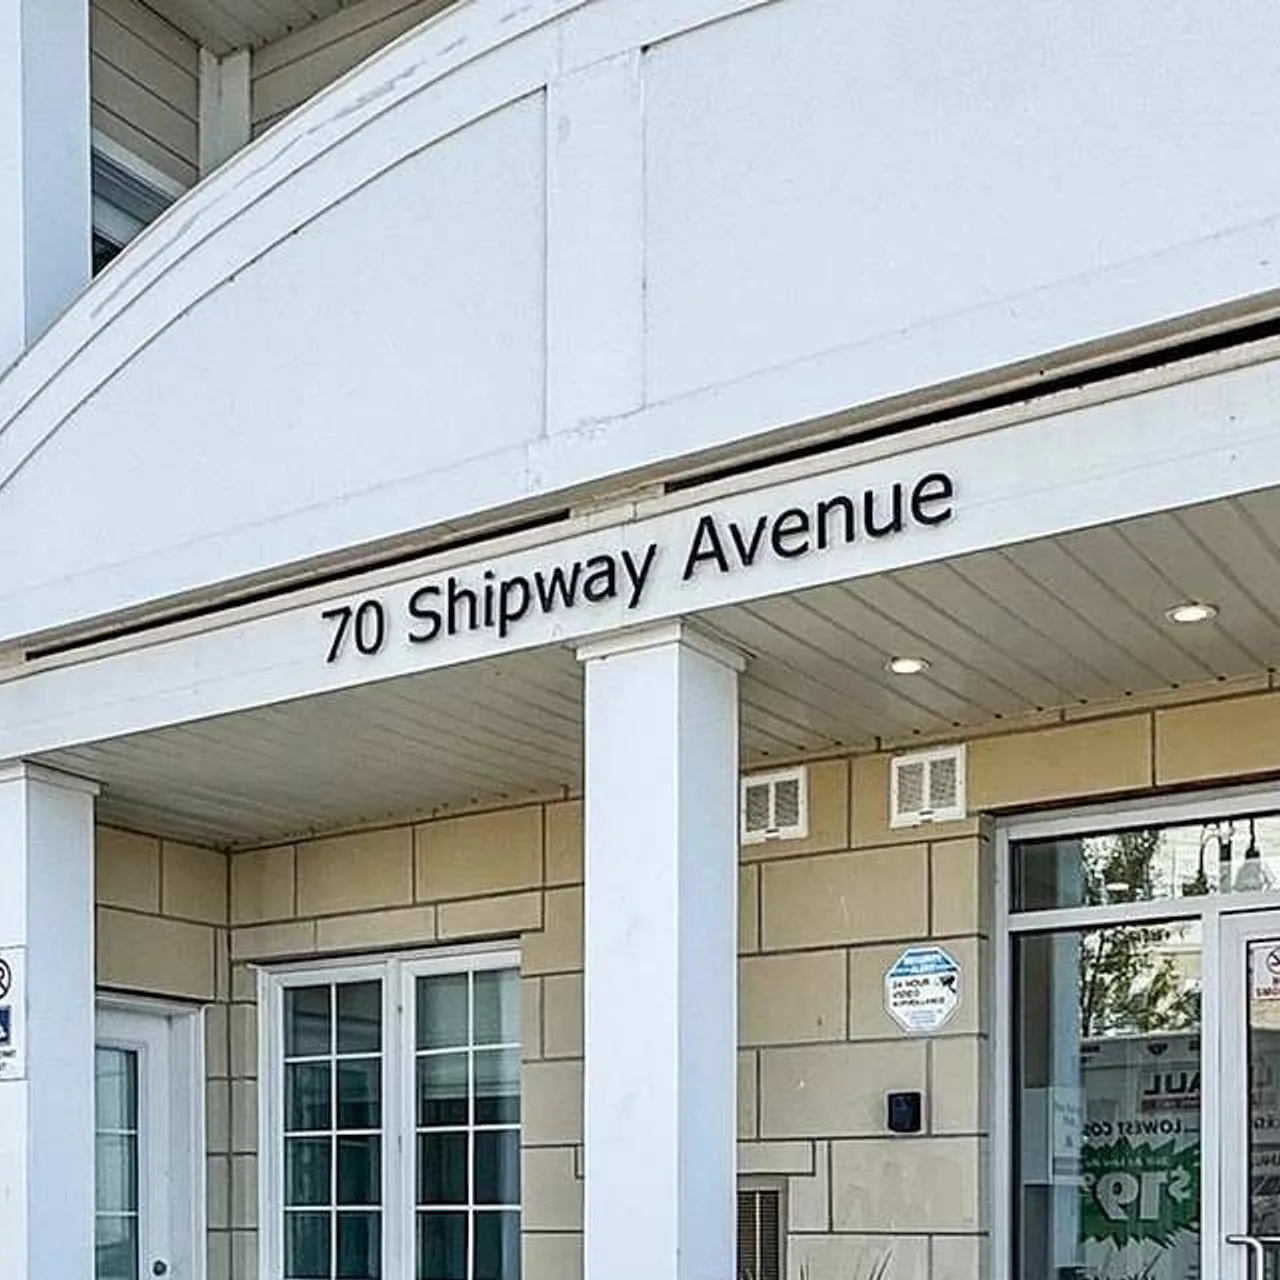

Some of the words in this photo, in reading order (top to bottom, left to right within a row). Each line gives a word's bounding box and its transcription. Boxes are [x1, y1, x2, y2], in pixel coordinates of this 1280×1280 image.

[322, 599, 384, 664] 70
[407, 543, 658, 645] Shipway
[682, 470, 956, 582] Avenue
